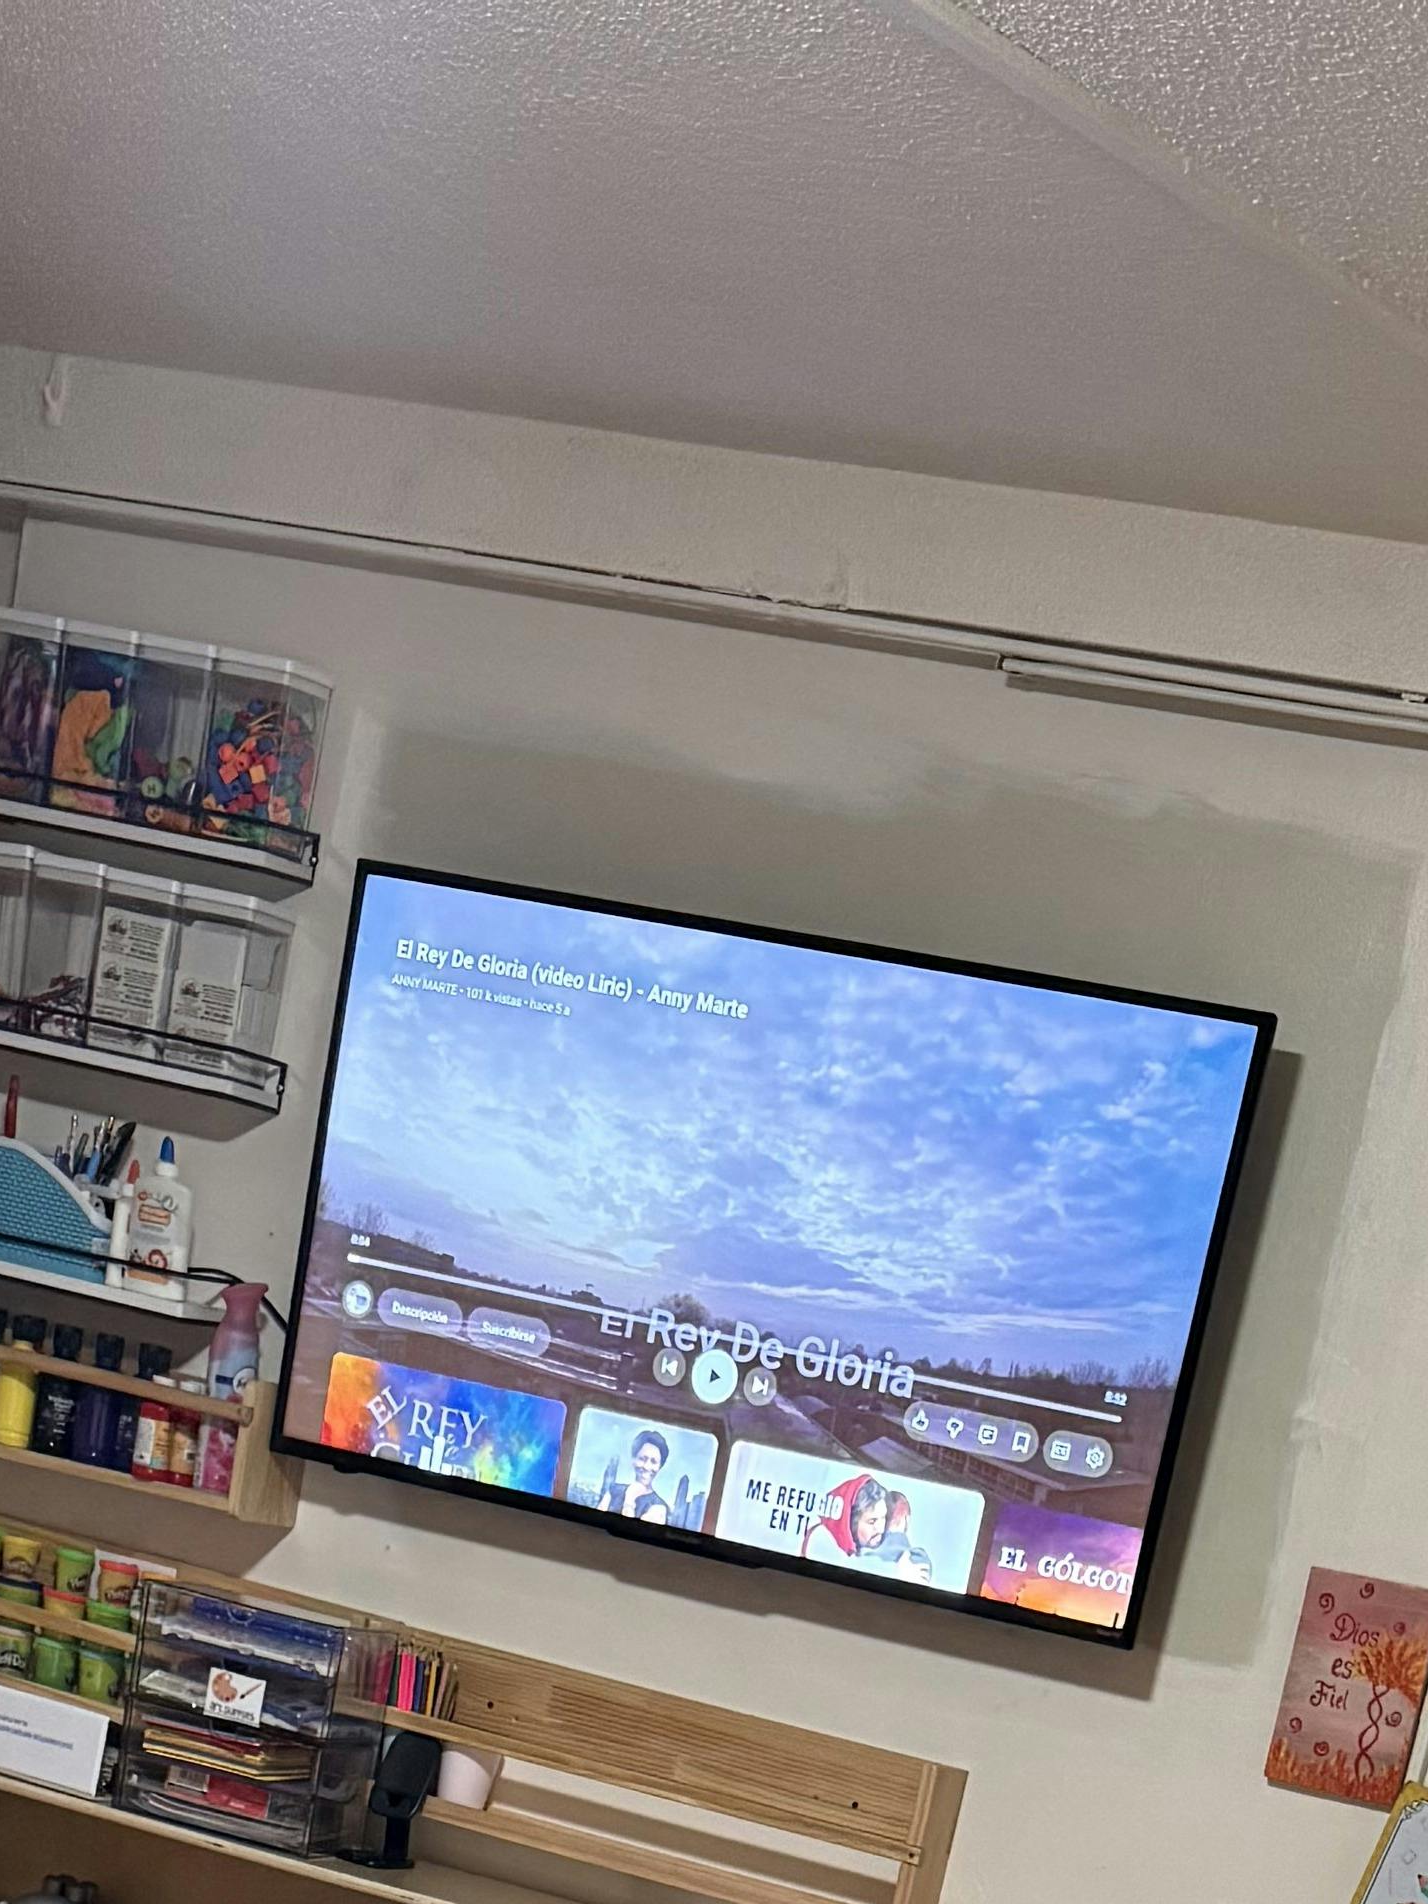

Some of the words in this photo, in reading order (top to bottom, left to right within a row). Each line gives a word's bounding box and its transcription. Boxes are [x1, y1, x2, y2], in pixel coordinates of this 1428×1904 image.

[392, 973, 422, 989] ANNY
[422, 978, 458, 997] MARTE
[529, 999, 554, 1014] hace
[396, 939, 414, 958] El
[420, 943, 448, 970] Rey
[452, 949, 474, 970] De
[477, 953, 528, 980] Gloria
[531, 962, 585, 991] (video
[587, 972, 633, 1002] Liric)
[647, 984, 693, 1014] Anny
[695, 992, 749, 1020] Marte
[646, 1307, 722, 1353] Rey
[731, 1321, 784, 1370] De
[795, 1336, 915, 1400] Gloria
[365, 1384, 408, 1431] EL
[746, 1479, 770, 1503] ME
[770, 1507, 794, 1530] EN
[998, 1546, 1028, 1572] EL
[1037, 1551, 1133, 1595] GÓLGOT
[1330, 1613, 1380, 1648] Dios
[1331, 1657, 1354, 1679] es
[1310, 1680, 1349, 1711] Fiel
